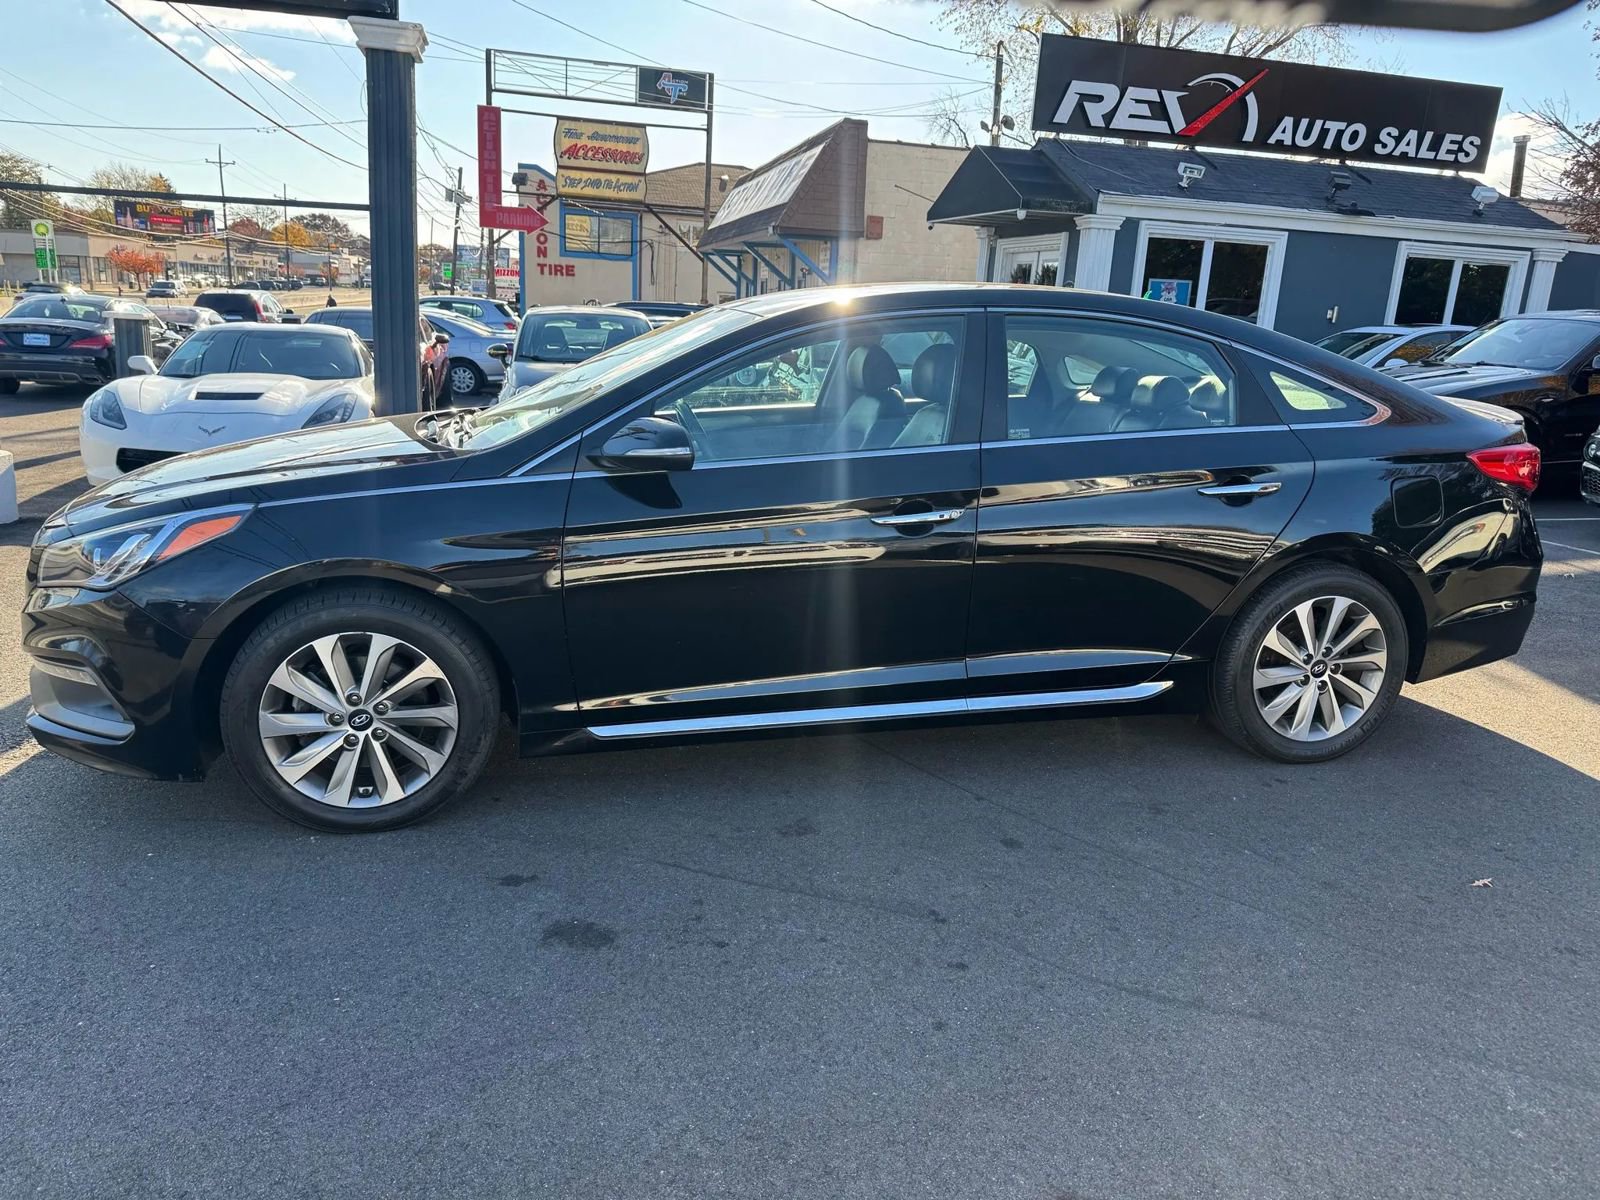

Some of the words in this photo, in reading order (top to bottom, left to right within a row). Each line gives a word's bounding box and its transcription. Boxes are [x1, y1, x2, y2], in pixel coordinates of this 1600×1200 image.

[1267, 116, 1367, 152] AUTO
[1374, 126, 1481, 164] SALES
[560, 143, 645, 165] ACCESSORIES
[496, 212, 541, 227] PARKING
[537, 263, 576, 277] TIRE
